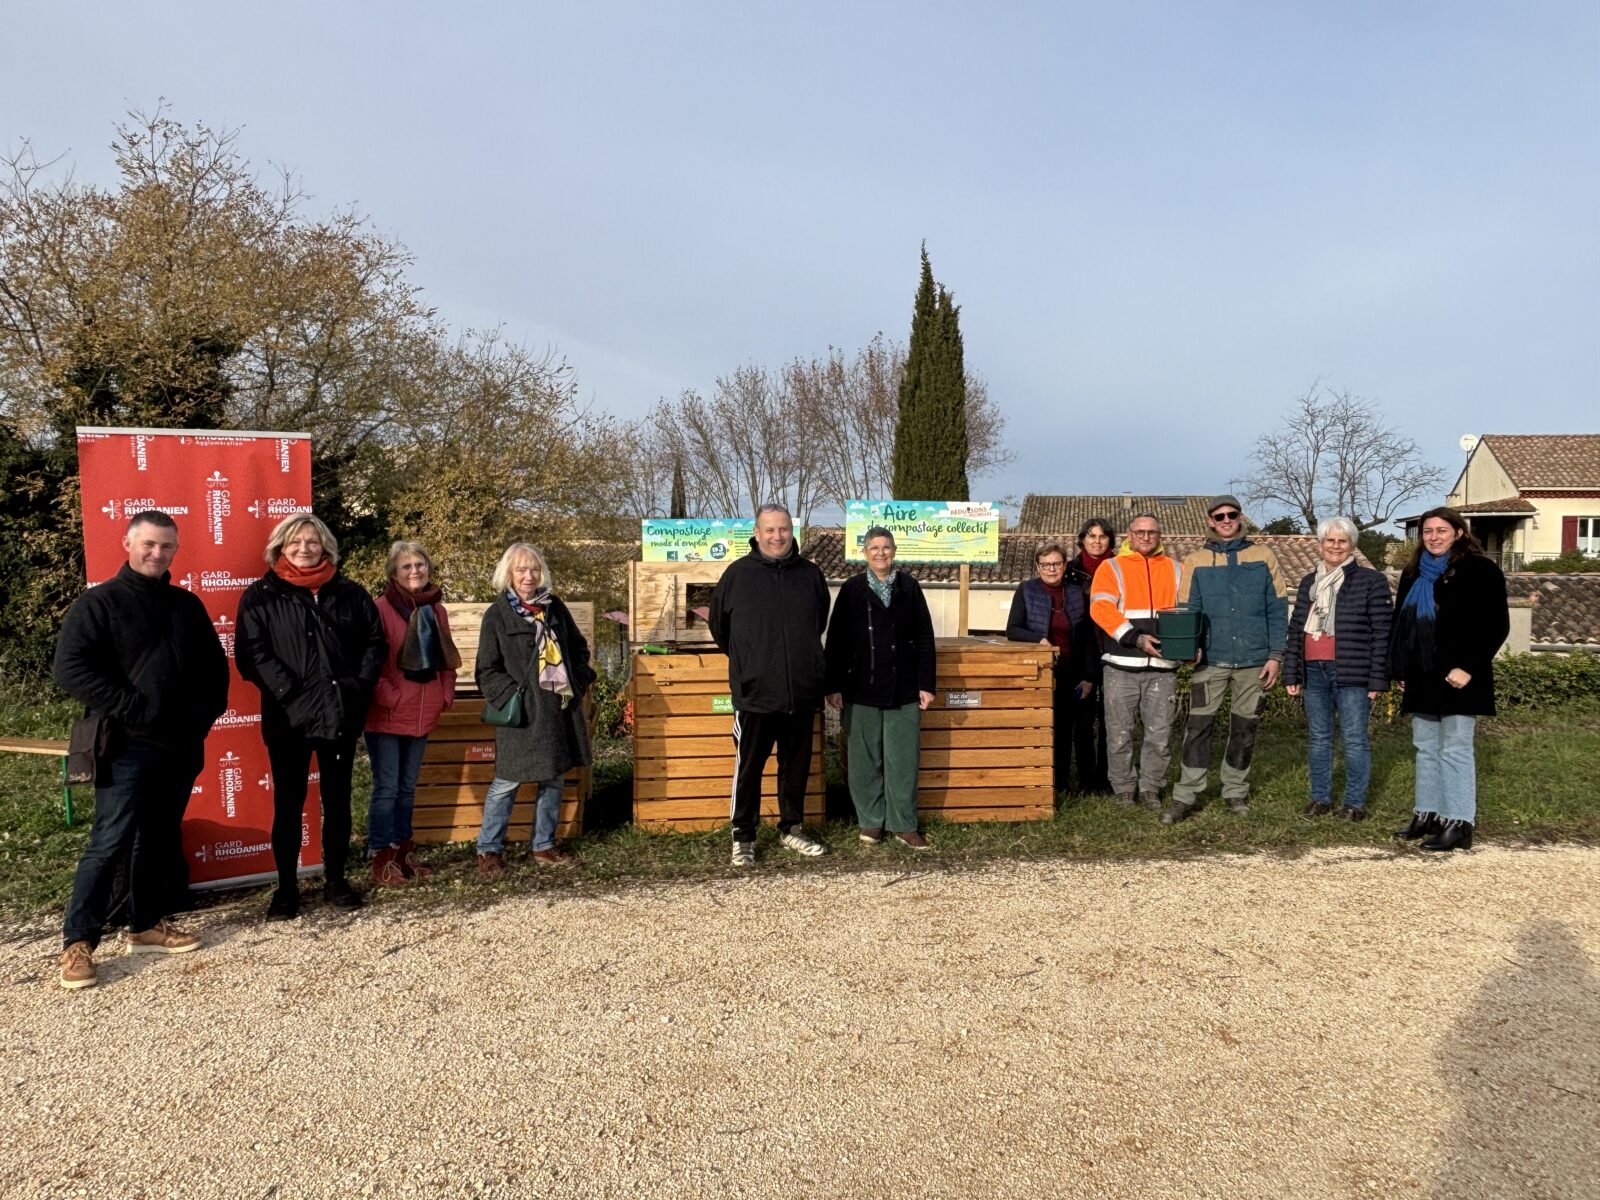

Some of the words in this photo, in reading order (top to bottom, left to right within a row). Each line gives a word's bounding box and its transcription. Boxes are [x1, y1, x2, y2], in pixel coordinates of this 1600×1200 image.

[123, 498, 155, 507] GARD
[221, 490, 231, 517] GARD
[267, 498, 297, 506] GARD
[212, 490, 224, 545] RHODANIEN
[267, 506, 313, 514] RHODANI
[883, 504, 917, 523] Aire
[647, 525, 712, 541] Compostage
[884, 521, 944, 538] compostage
[947, 521, 989, 534] collectif
[651, 539, 672, 547] mode
[201, 570, 231, 580] GARD
[202, 577, 262, 587] RHODANIE
[213, 714, 262, 725] HODANIE
[233, 768, 243, 792] GARD
[225, 768, 236, 818] RHODANIEN
[301, 823, 310, 847] GARD
[214, 840, 243, 850] GARD
[215, 842, 272, 857] RHODANIEN
